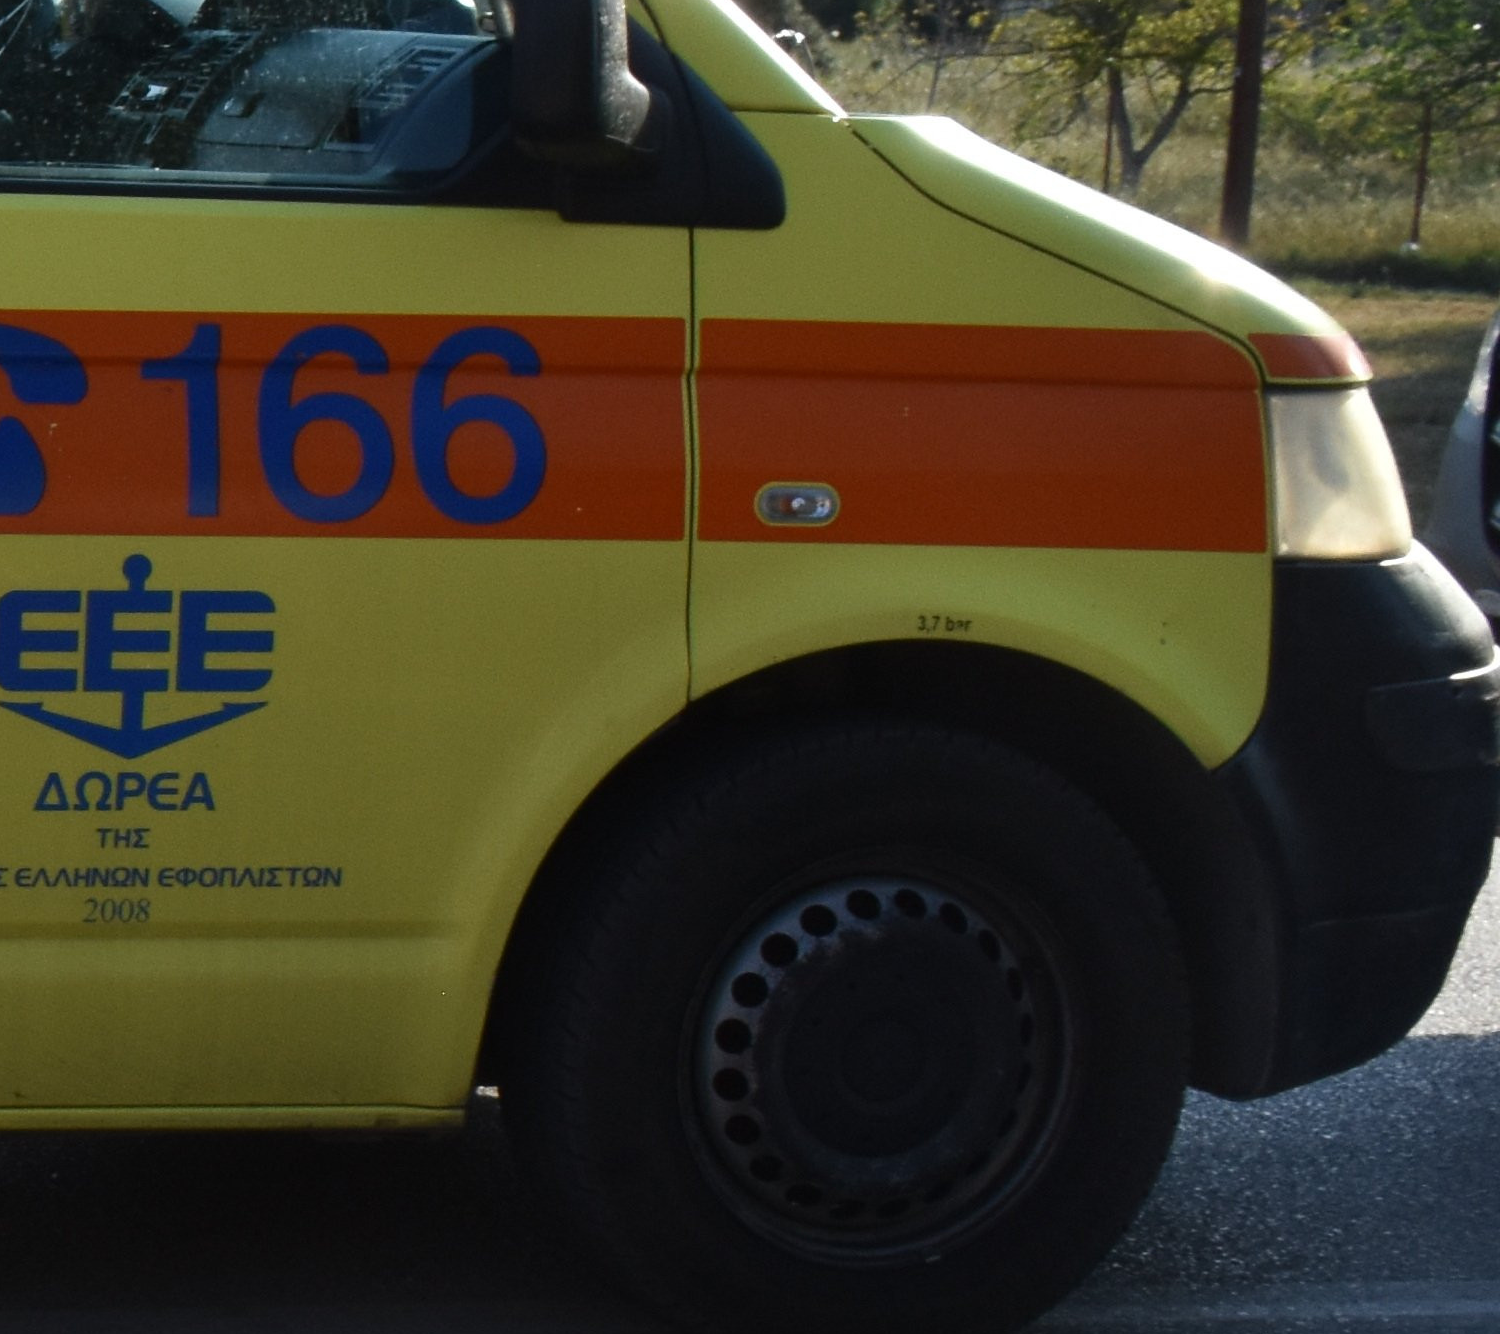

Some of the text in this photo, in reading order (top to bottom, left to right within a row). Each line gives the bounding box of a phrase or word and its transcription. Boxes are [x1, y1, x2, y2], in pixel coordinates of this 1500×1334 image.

[140, 323, 547, 525] 166
[32, 771, 217, 813] ΔΩΡΕΑ
[97, 827, 151, 850] ΤΗΣ
[14, 866, 151, 890] ΕΛΛΗΝΩΝ
[156, 866, 343, 890] ΕΦΟΠΛΙΣΤΩΝ
[81, 897, 152, 925] 2008
